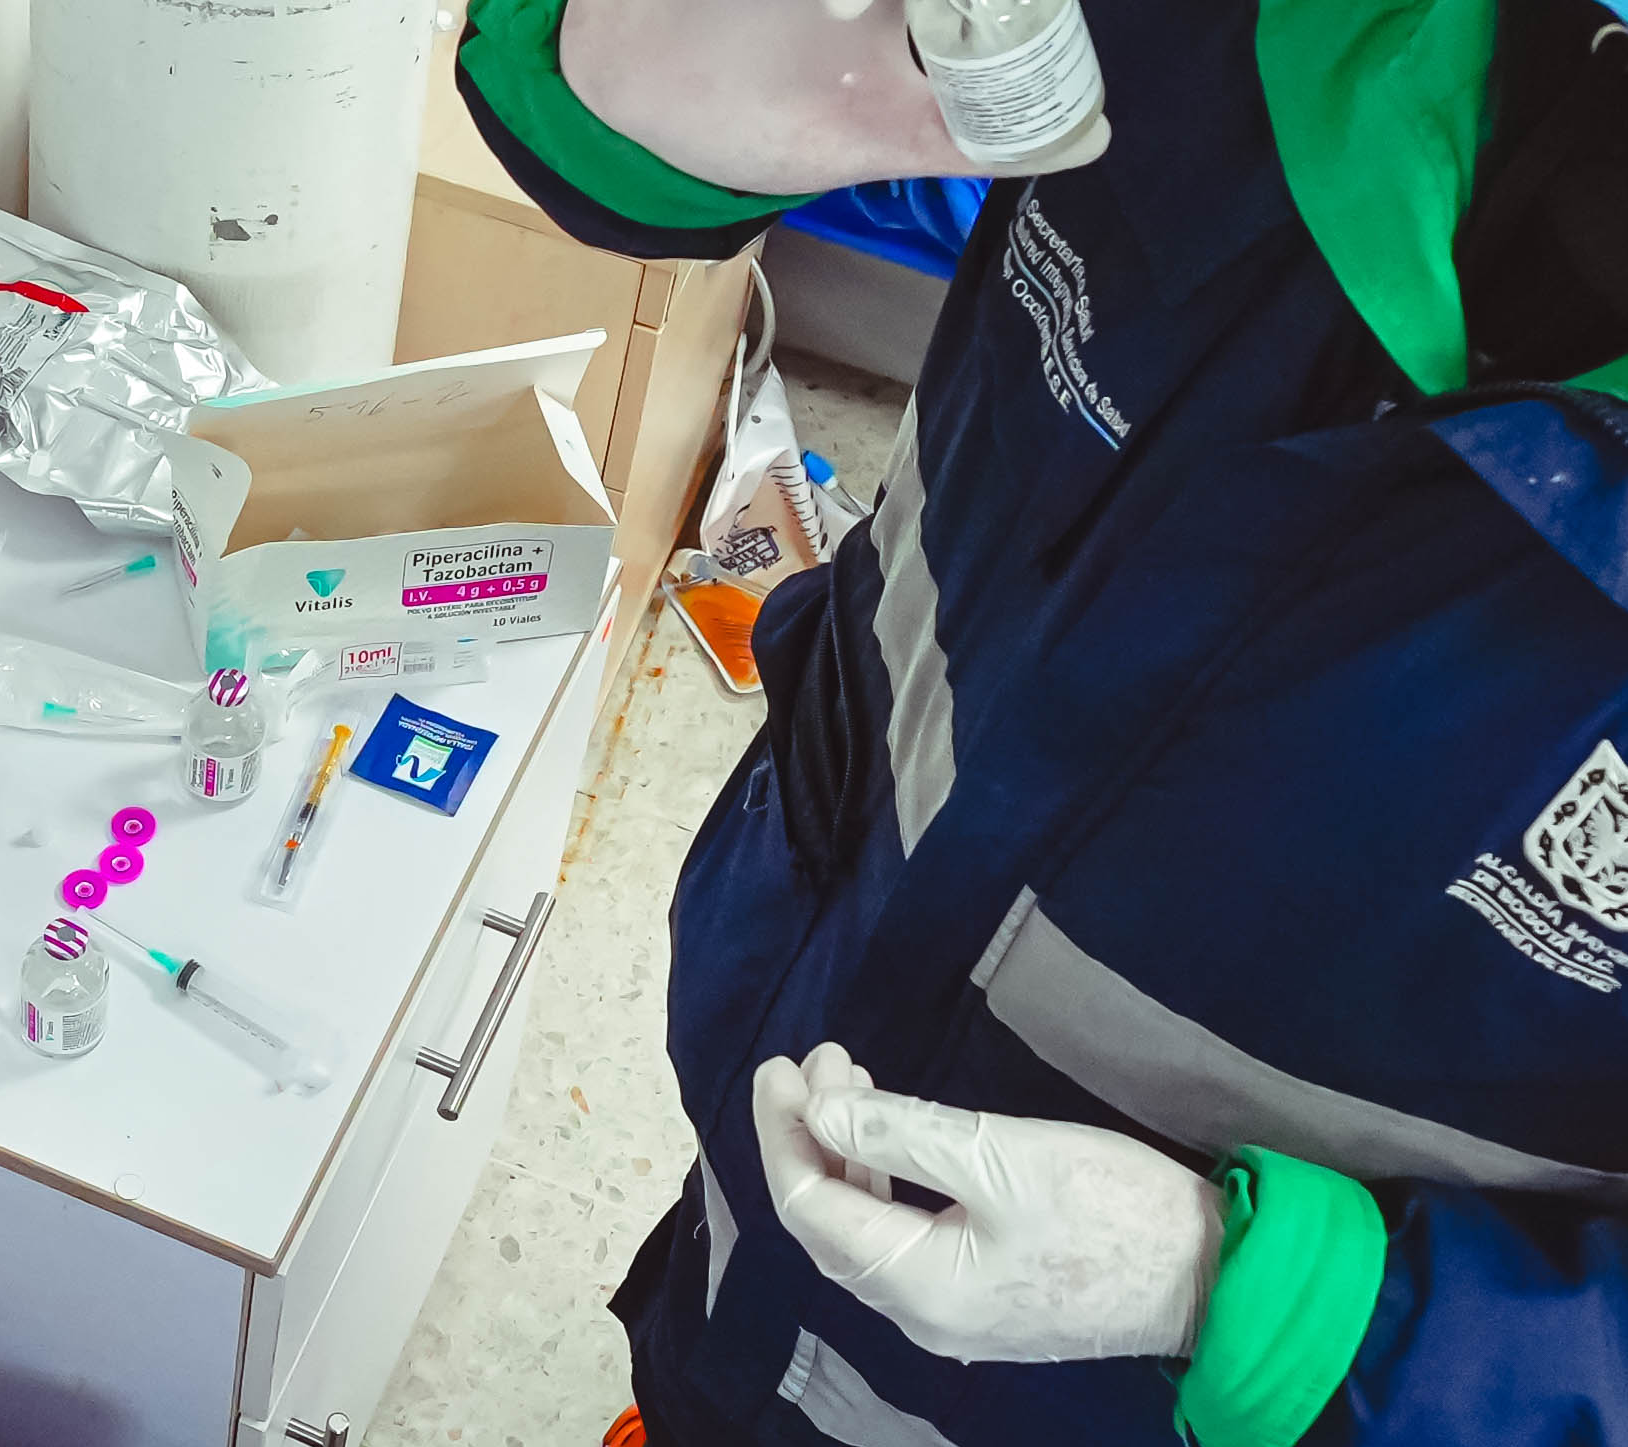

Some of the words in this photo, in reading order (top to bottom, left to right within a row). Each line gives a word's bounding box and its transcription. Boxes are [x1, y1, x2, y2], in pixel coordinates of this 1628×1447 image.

[412, 544, 524, 568] Piperacilina
[532, 546, 544, 556] +
[422, 560, 533, 583] Tazobactam
[456, 585, 467, 598] 4
[295, 596, 354, 614] Vitalis
[492, 617, 507, 627] 10
[509, 613, 542, 625] Viales
[347, 646, 393, 665] 10ml
